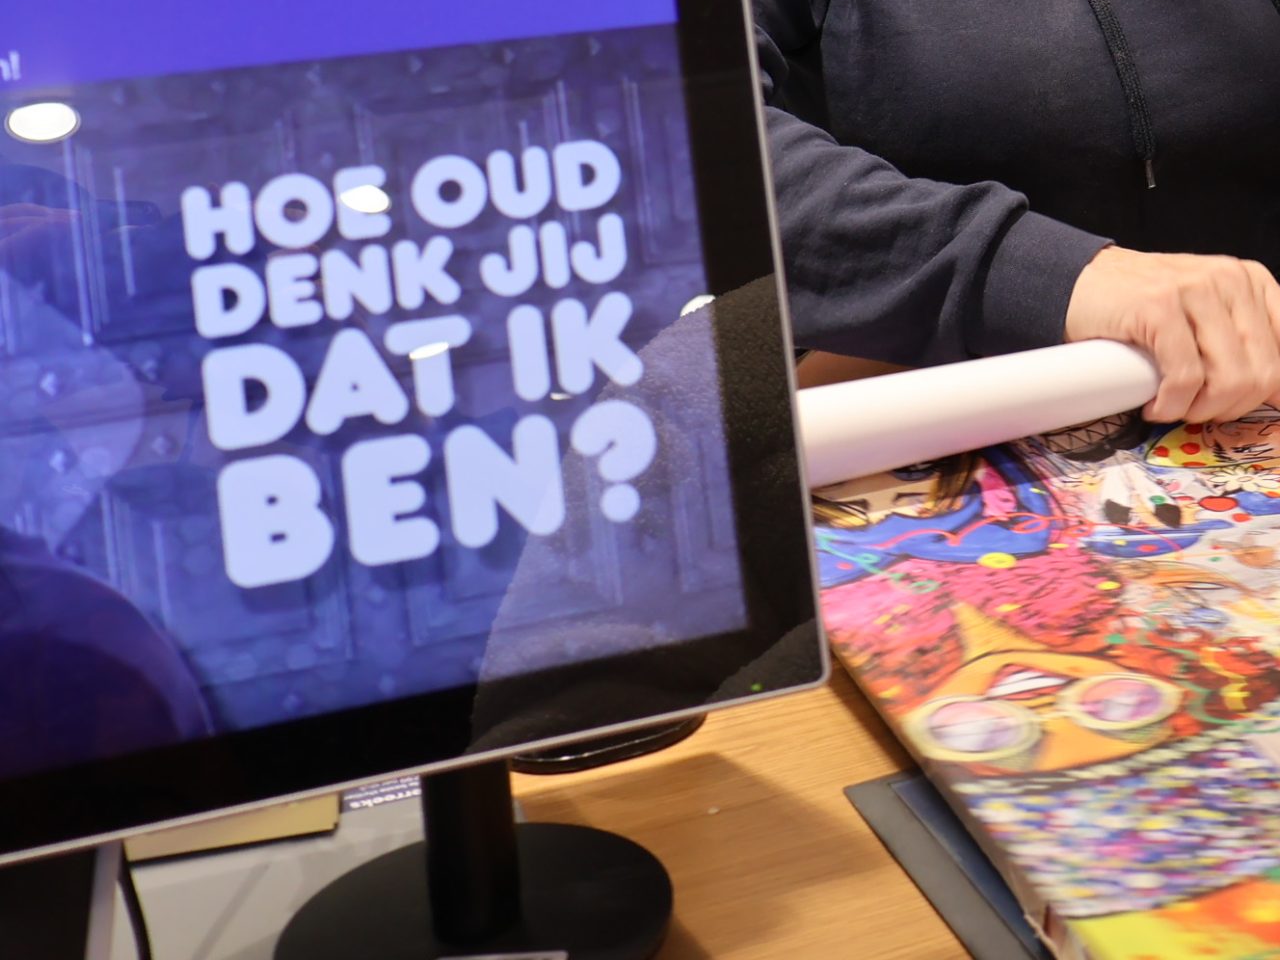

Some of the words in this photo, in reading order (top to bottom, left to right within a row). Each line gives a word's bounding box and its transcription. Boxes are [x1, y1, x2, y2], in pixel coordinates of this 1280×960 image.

[181, 165, 391, 260] HOE
[411, 139, 622, 229] OUD
[190, 236, 462, 339] DENK
[480, 213, 628, 297] JIJ
[201, 315, 473, 451] DAT
[506, 290, 645, 403] IK
[216, 400, 658, 590] BEN?
